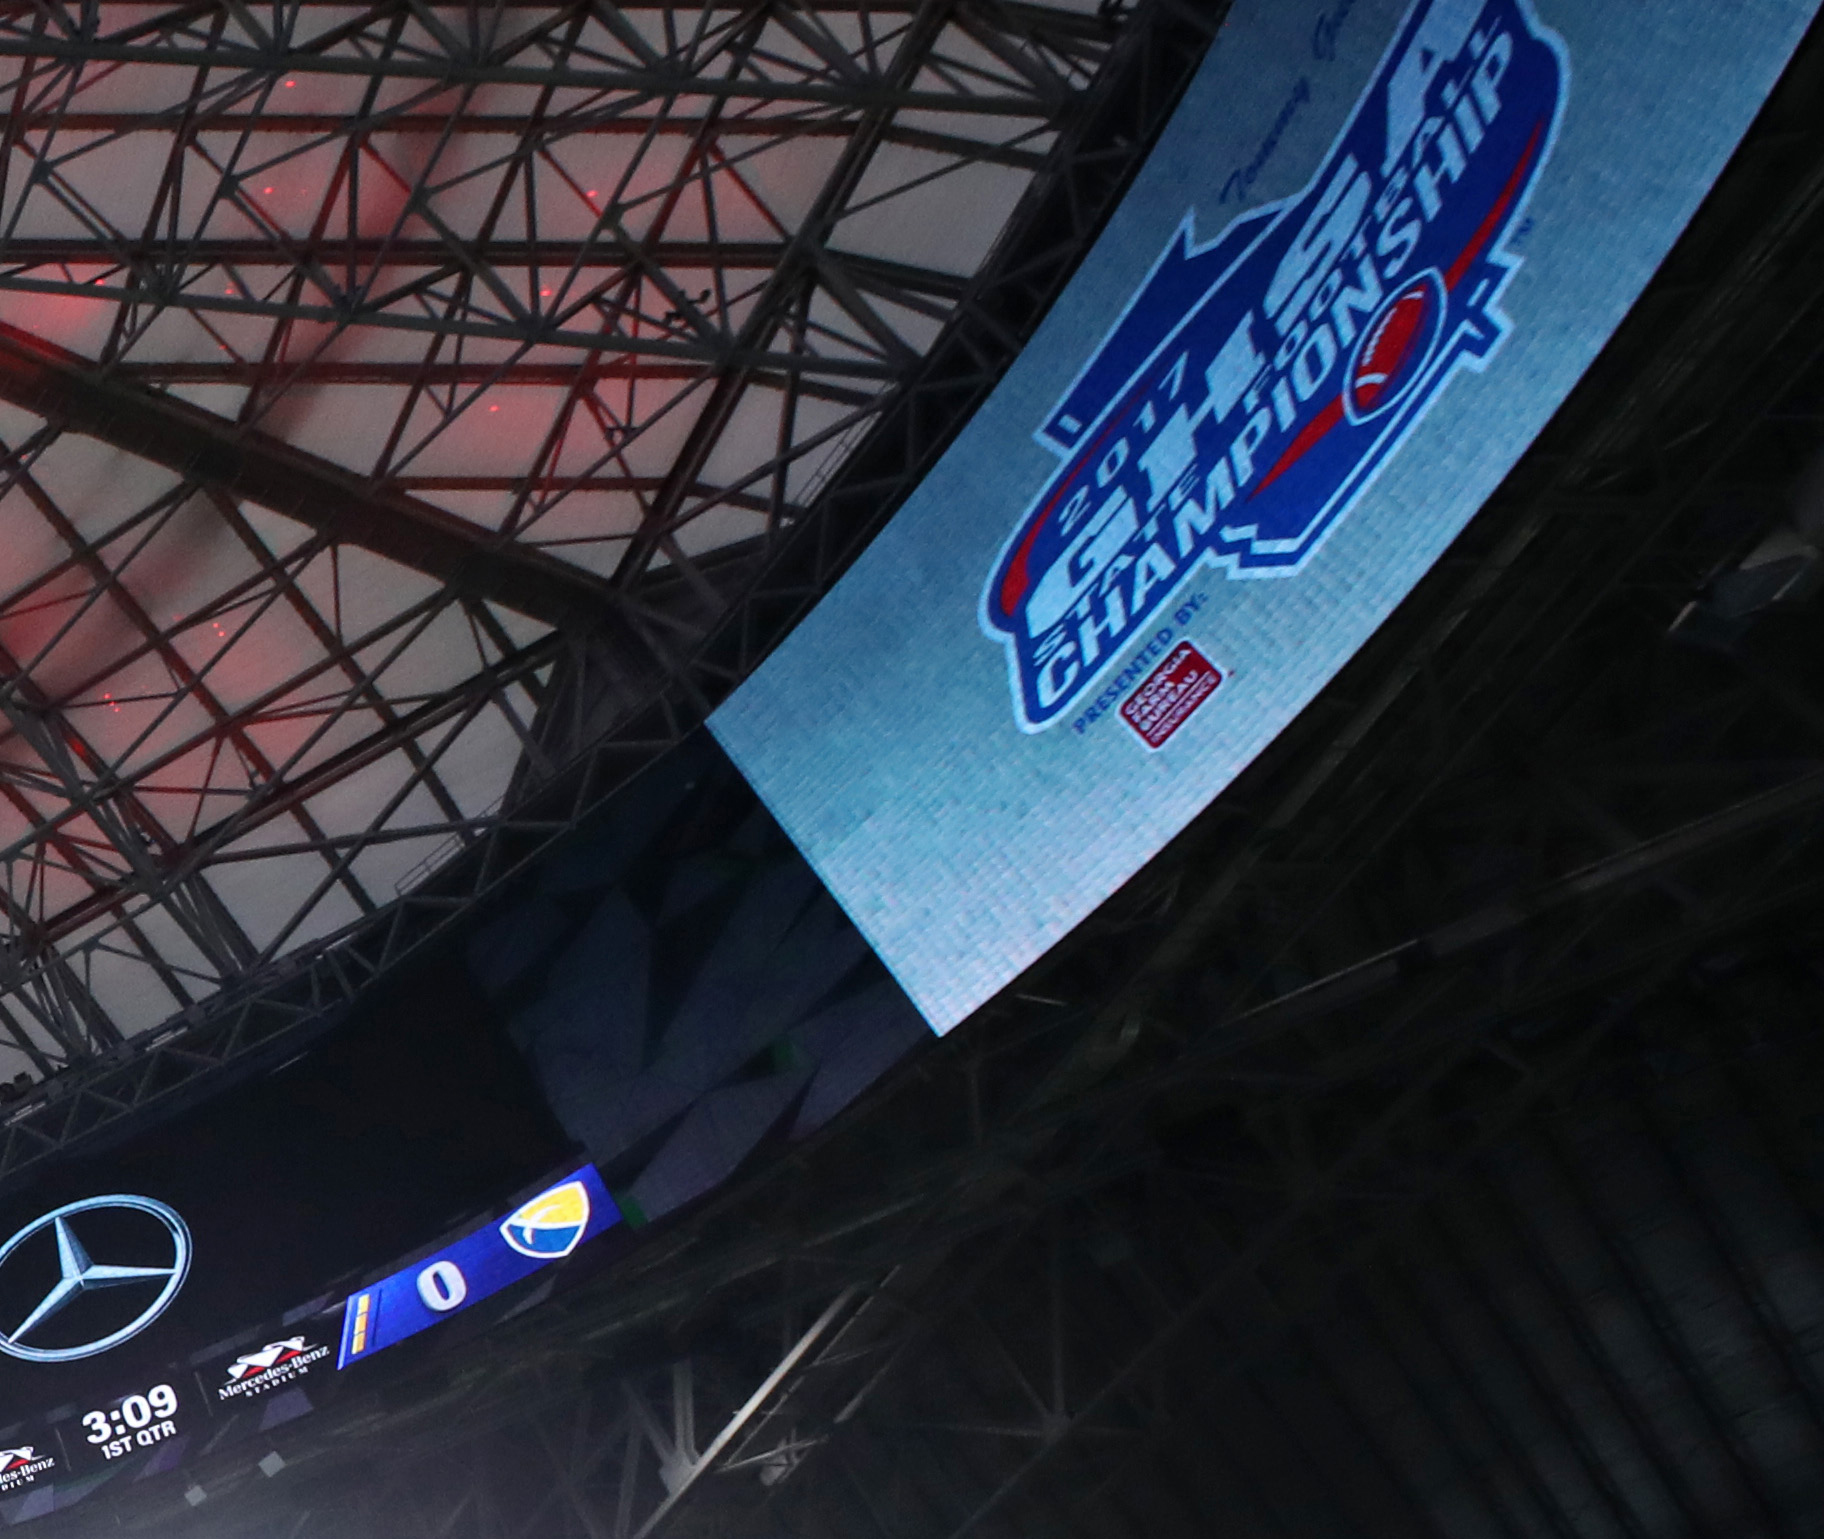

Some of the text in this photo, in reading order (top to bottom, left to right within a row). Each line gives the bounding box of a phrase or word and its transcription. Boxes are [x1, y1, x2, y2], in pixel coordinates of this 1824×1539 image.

[1024, 0, 1487, 639] GHSA
[1033, 15, 1503, 666] STATE FOOTBALL
[1036, 30, 1513, 709] CHAMPIONSHIP
[1058, 349, 1190, 537] 2017
[1072, 627, 1174, 735] PRESENTED
[415, 1260, 468, 1313] 0
[81, 1383, 178, 1445] 3:09
[217, 1343, 331, 1401] Mercedes-Benz
[244, 1364, 310, 1399] STADIUM
[99, 1420, 178, 1461] 1ST QTR
